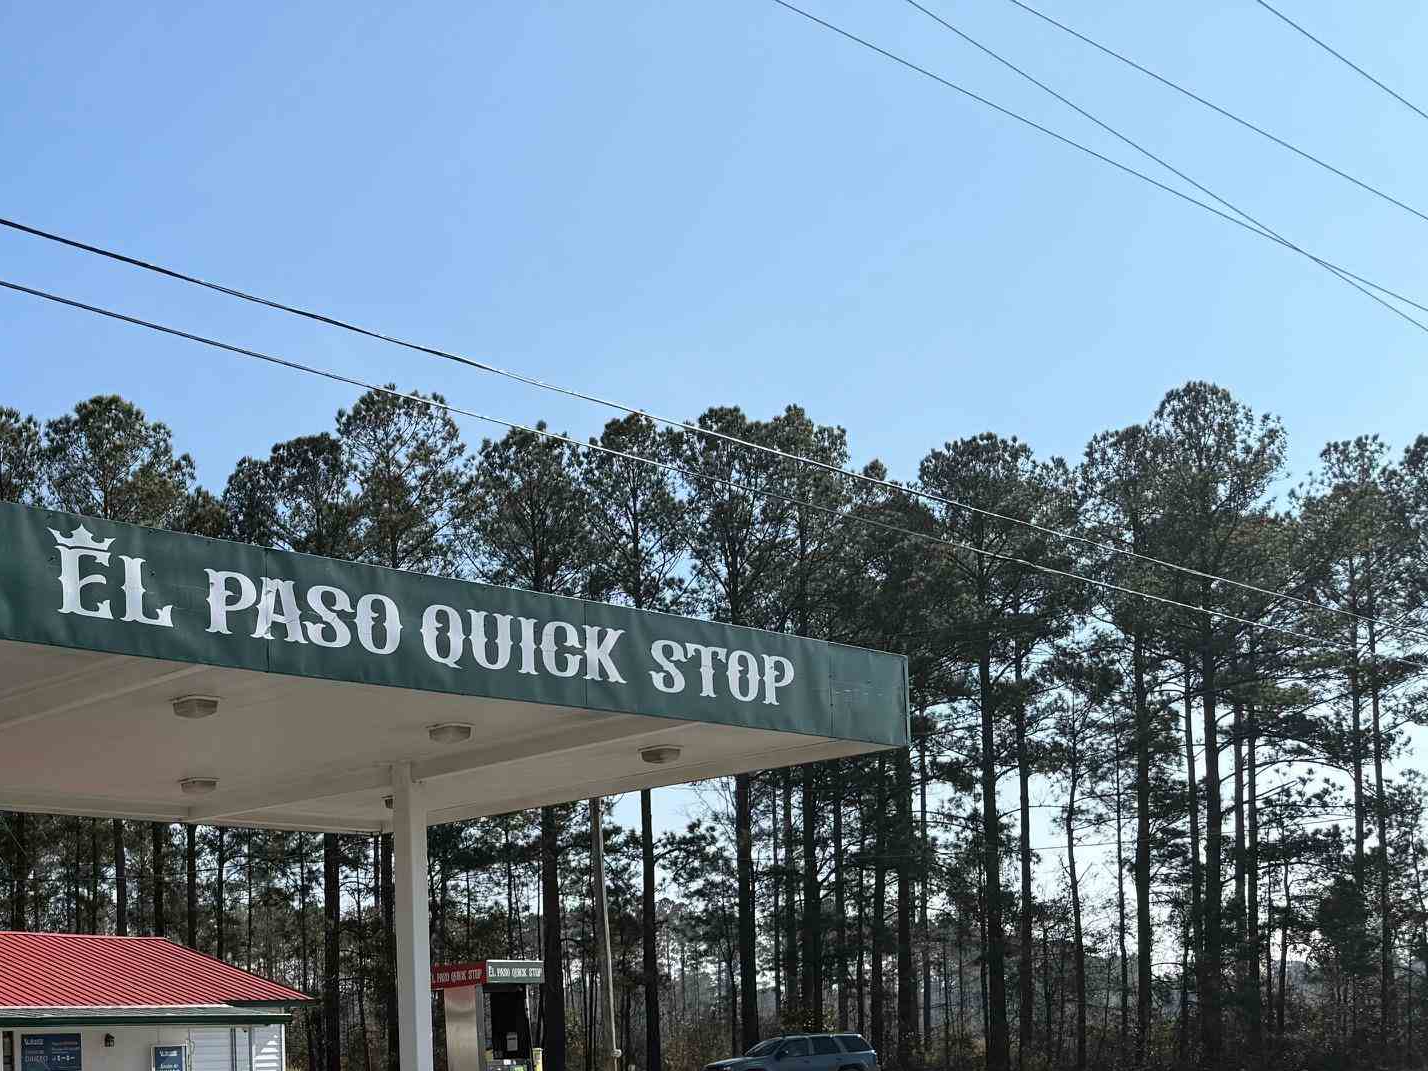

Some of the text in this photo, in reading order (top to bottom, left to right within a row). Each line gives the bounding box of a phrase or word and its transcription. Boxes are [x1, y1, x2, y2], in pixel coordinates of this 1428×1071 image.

[56, 546, 796, 707] EL PASO QUICK STOP
[468, 968, 483, 980] STOP
[488, 966, 542, 978] EL PASO QUICK STOP
